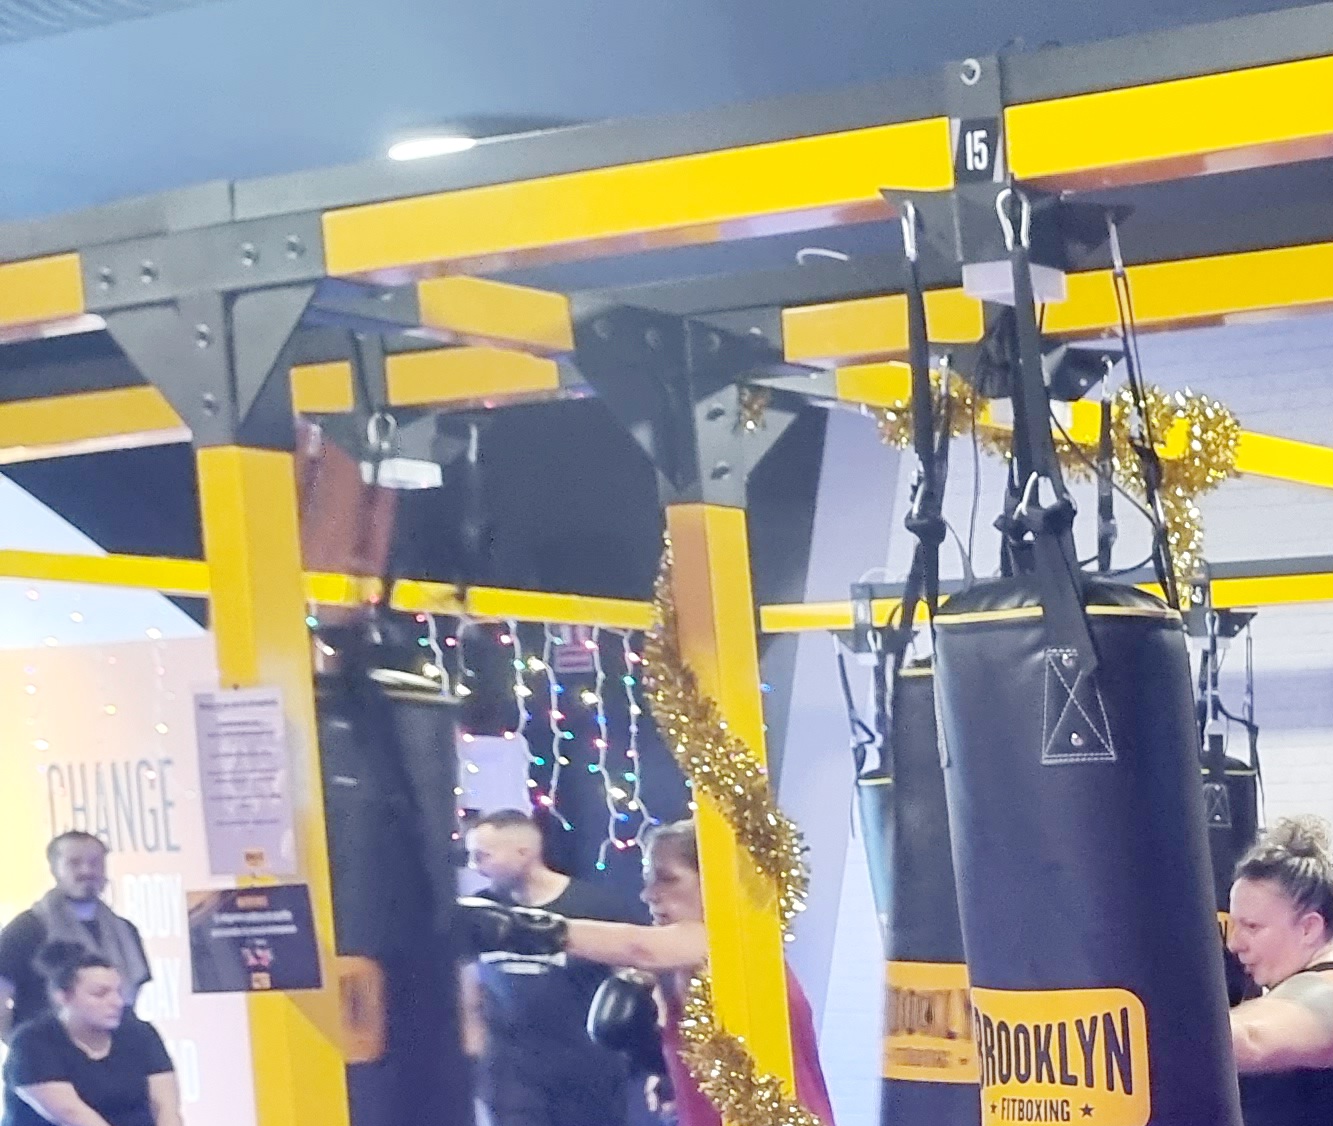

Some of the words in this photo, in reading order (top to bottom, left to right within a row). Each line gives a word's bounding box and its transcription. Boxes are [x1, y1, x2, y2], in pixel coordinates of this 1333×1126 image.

[965, 130, 988, 171] 15
[47, 758, 181, 853] CHANGE
[974, 1006, 1133, 1096] BROOKLYN
[1001, 1097, 1070, 1122] FITBOXING
